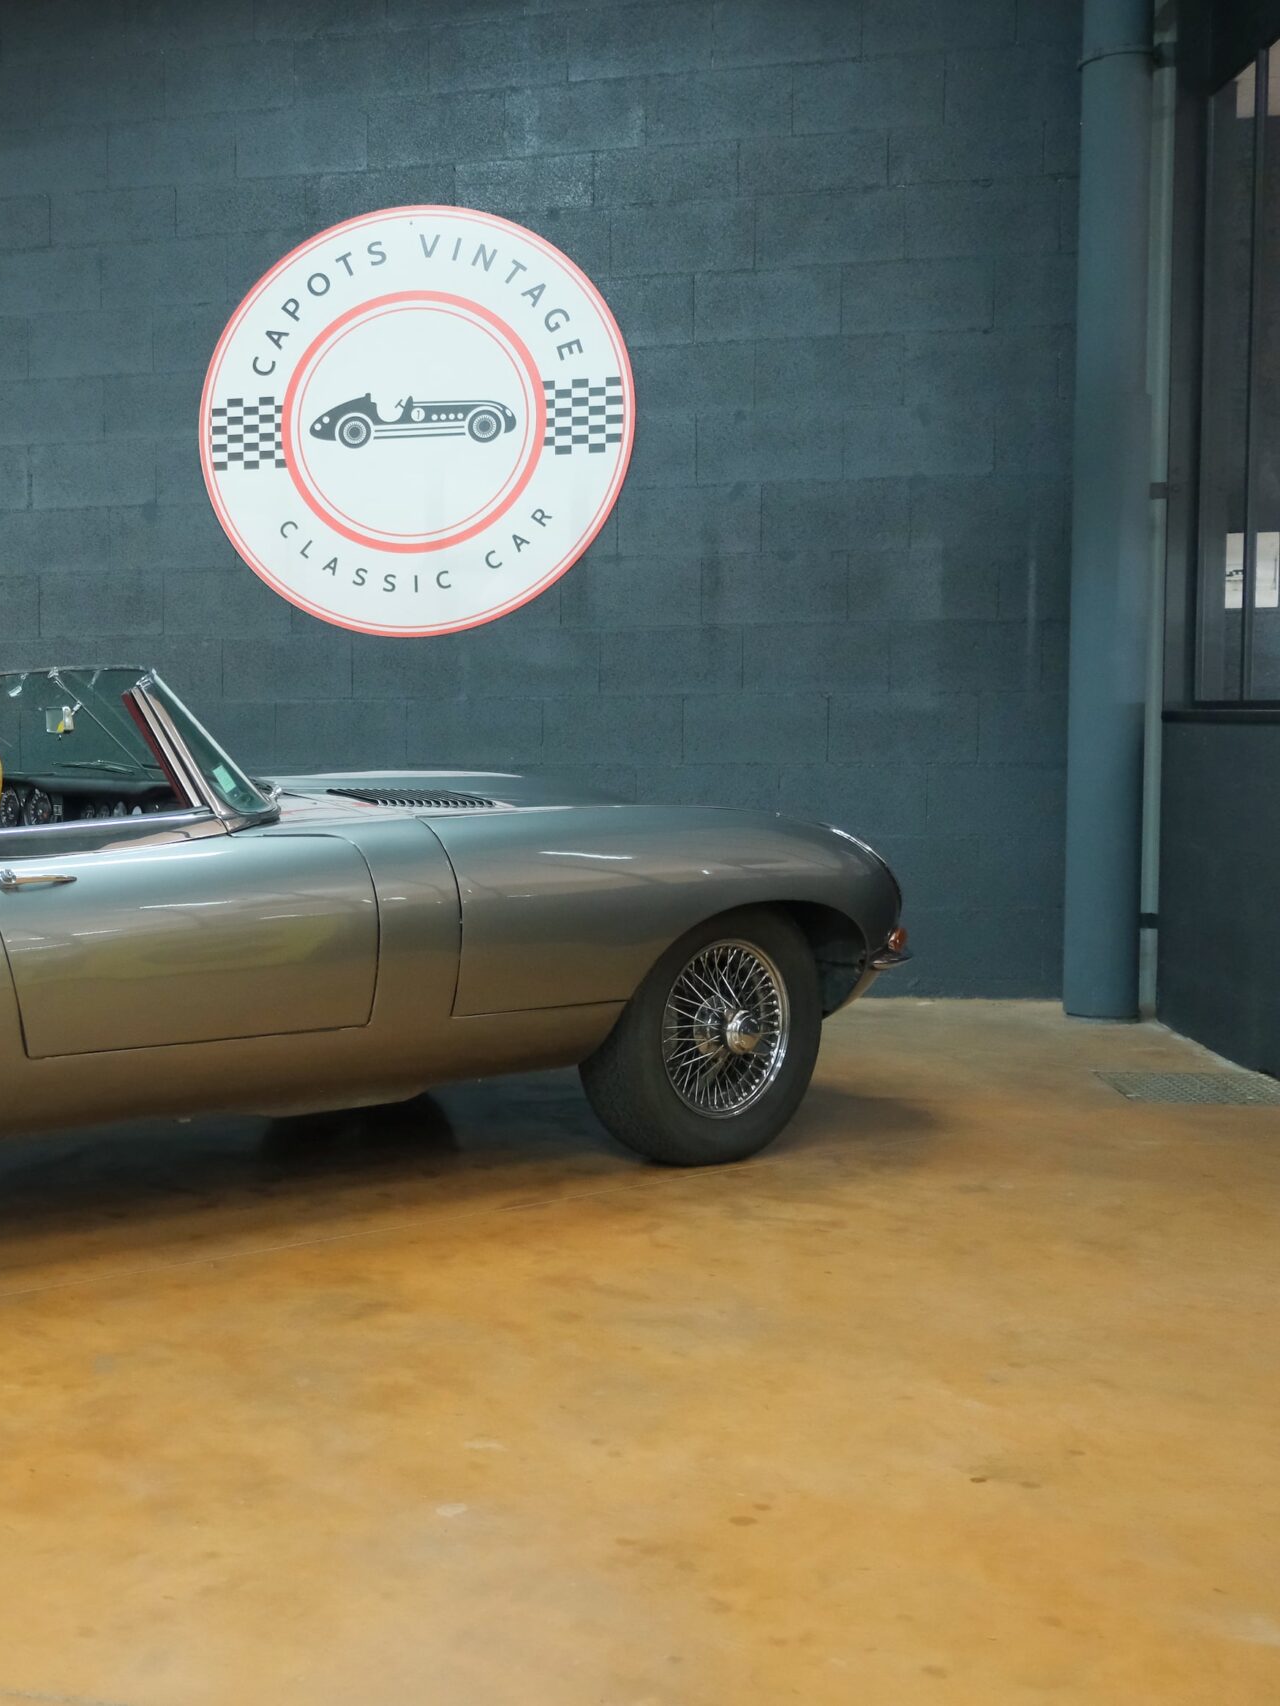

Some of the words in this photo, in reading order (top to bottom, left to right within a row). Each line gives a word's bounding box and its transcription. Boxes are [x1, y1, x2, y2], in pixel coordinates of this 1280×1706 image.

[252, 240, 387, 376] CAPOTS
[419, 234, 584, 361] VINTAGE
[279, 520, 452, 593] CLASSIC
[484, 507, 553, 570] CAR
